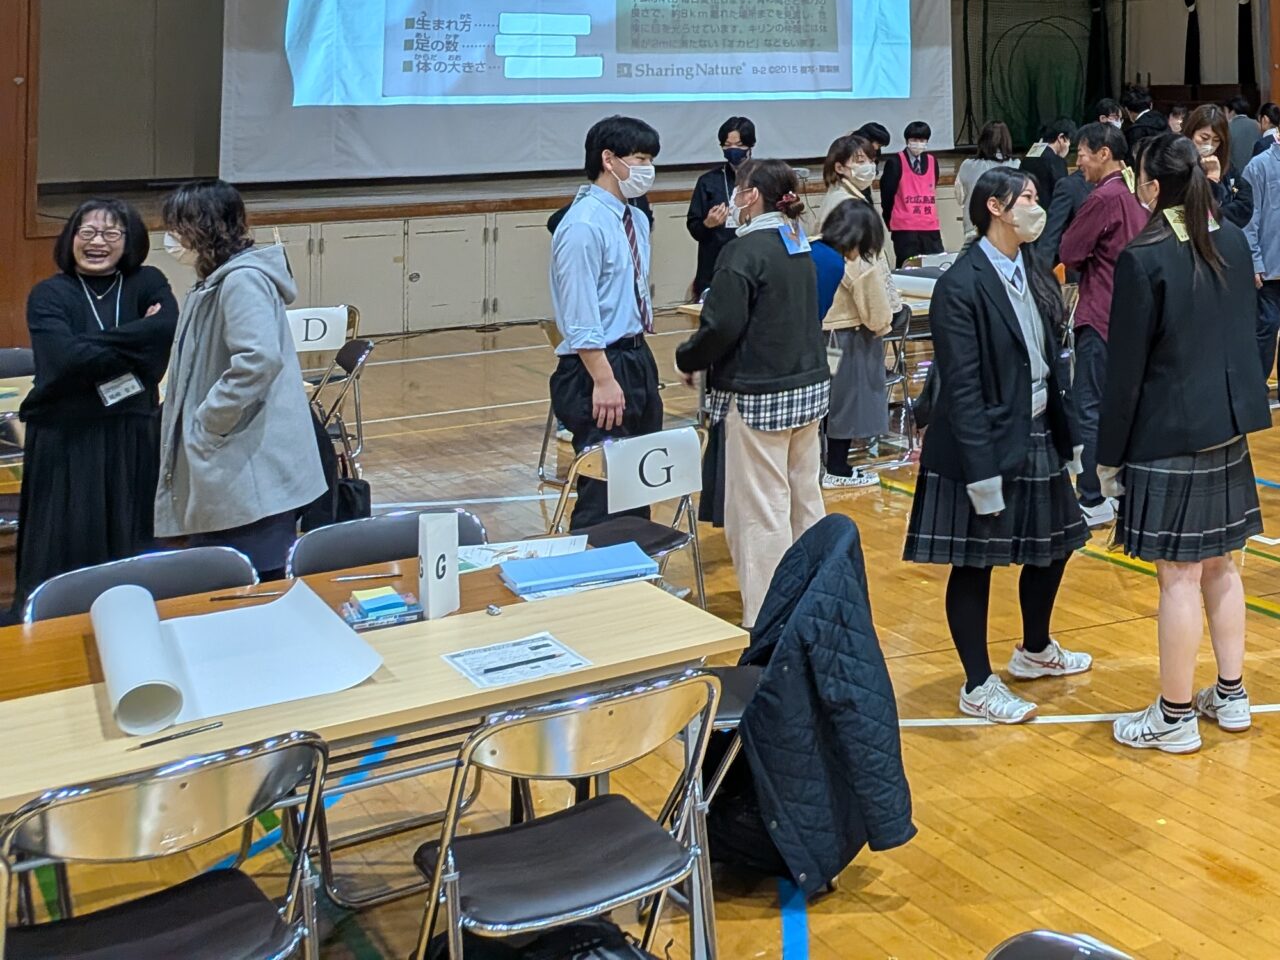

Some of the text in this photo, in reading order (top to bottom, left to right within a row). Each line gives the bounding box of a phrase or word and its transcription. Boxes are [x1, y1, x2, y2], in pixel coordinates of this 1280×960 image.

[415, 15, 472, 32] 生まれ方
[415, 39, 459, 52] 足の数
[415, 60, 486, 73] 体の大きさ
[635, 63, 694, 80] Sharing
[912, 206, 931, 215] 高校
[302, 317, 328, 342] D
[638, 447, 674, 488] G
[435, 553, 446, 579] G
